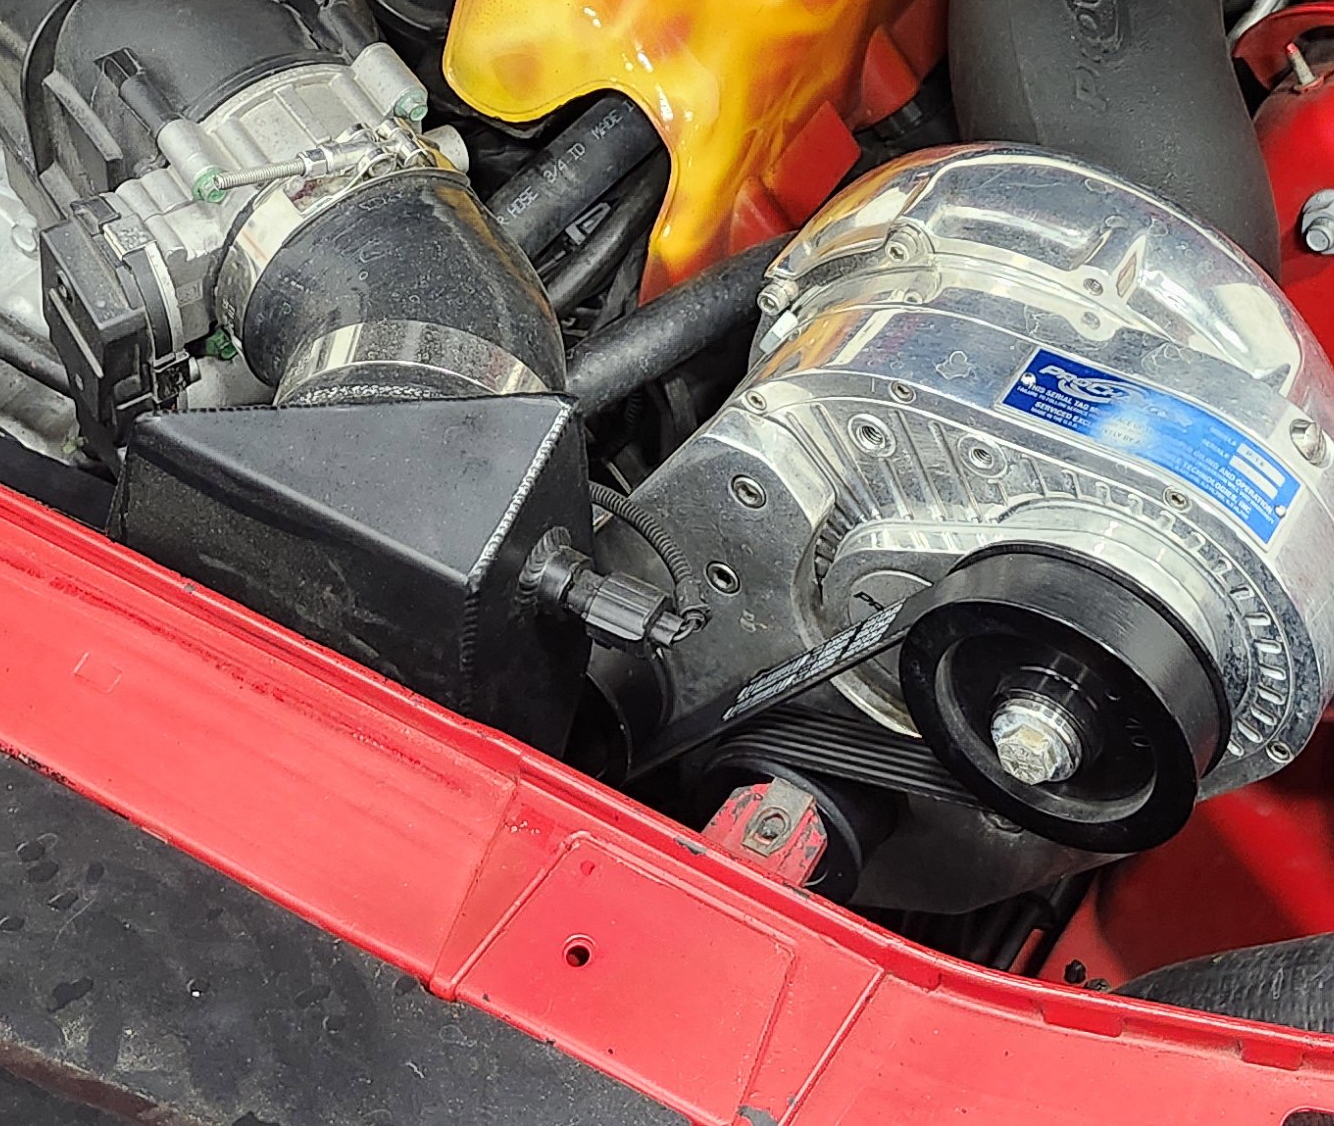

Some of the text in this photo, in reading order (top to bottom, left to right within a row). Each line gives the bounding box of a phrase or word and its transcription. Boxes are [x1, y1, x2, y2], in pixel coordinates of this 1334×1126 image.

[507, 186, 539, 218] HOSE
[591, 109, 623, 140] MADE
[1034, 401, 1072, 419] SERVICED
[1046, 388, 1073, 405] SERIAL
[1073, 399, 1089, 411] TAG
[1219, 466, 1236, 483] AND
[1236, 478, 1273, 514] OPERATION
